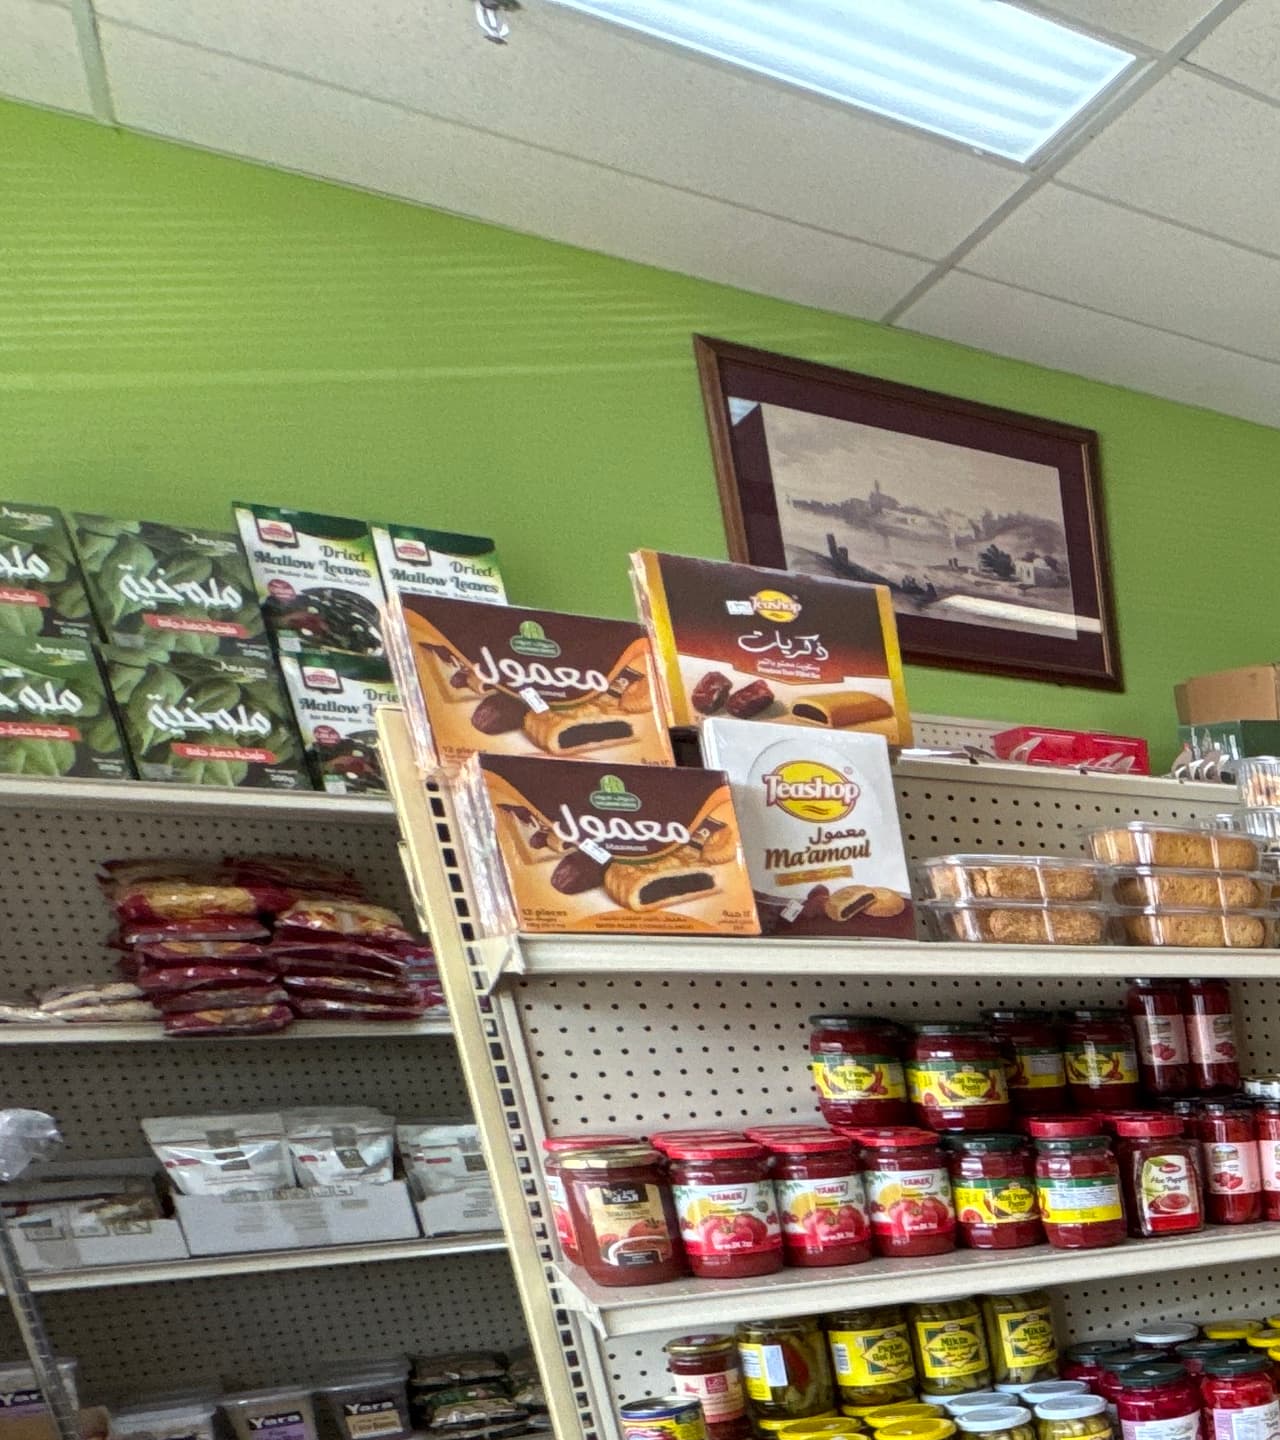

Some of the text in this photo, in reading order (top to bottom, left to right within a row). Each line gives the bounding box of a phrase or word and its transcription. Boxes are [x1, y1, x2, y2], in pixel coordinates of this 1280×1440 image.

[319, 545, 367, 563] Dried
[254, 551, 316, 571] Mallow
[318, 560, 372, 579] Leaves
[450, 560, 494, 578] Dried
[390, 568, 447, 586] Mallow
[450, 576, 499, 594] Leaves
[475, 646, 609, 692] معمول
[300, 697, 360, 714] Mallow
[762, 774, 862, 807] Teashop
[553, 804, 691, 844] معمول
[808, 827, 867, 846] معمول
[816, 1184, 846, 1195] TAMEK
[903, 1176, 931, 1187] TAMEK
[711, 1190, 744, 1202] TAMEK
[344, 1400, 394, 1415] Yara
[249, 1413, 300, 1429] Yara
